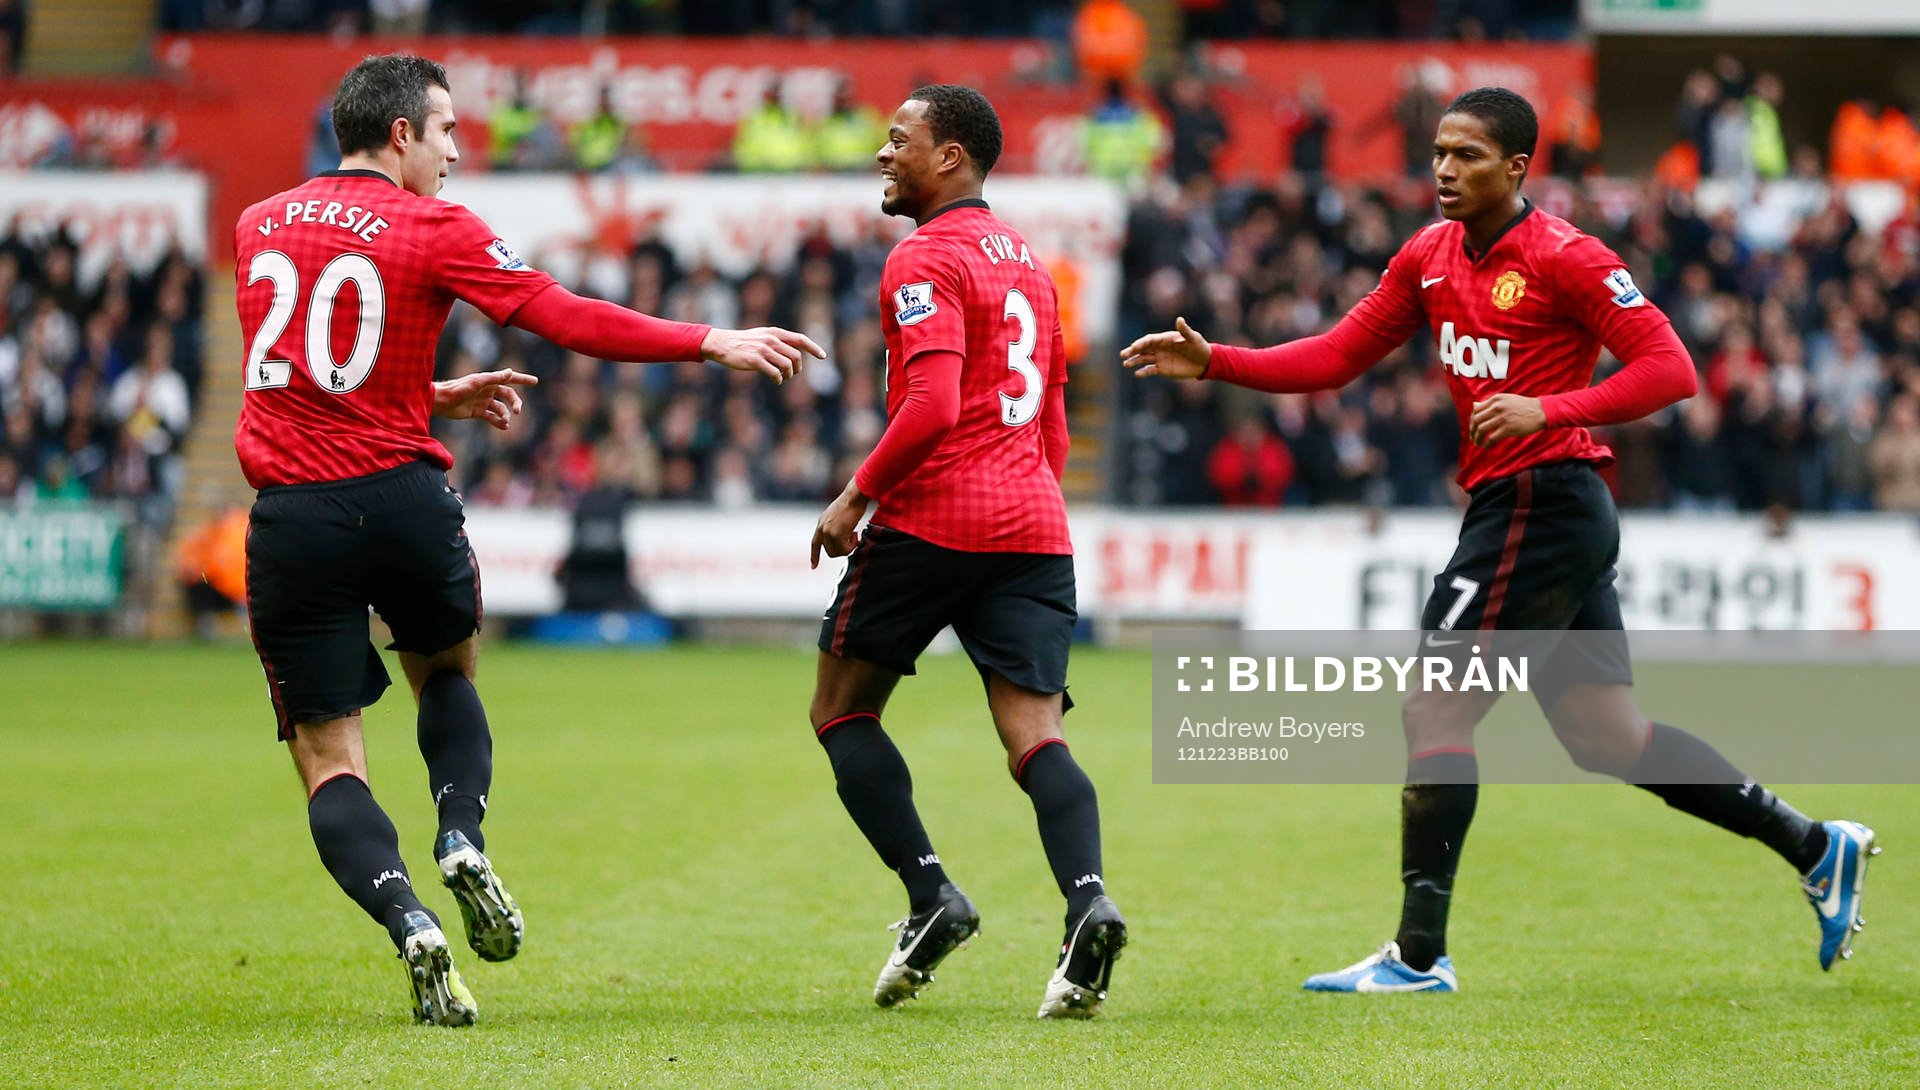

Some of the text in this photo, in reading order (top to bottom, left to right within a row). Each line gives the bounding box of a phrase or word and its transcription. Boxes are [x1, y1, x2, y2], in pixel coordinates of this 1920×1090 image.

[285, 200, 389, 243] PERSIE
[980, 234, 1034, 271] EVRA
[246, 249, 386, 395] 20
[999, 288, 1043, 427] 3
[1100, 533, 1250, 594] SPA
[1438, 575, 1481, 632] 7
[918, 854, 941, 866] MU
